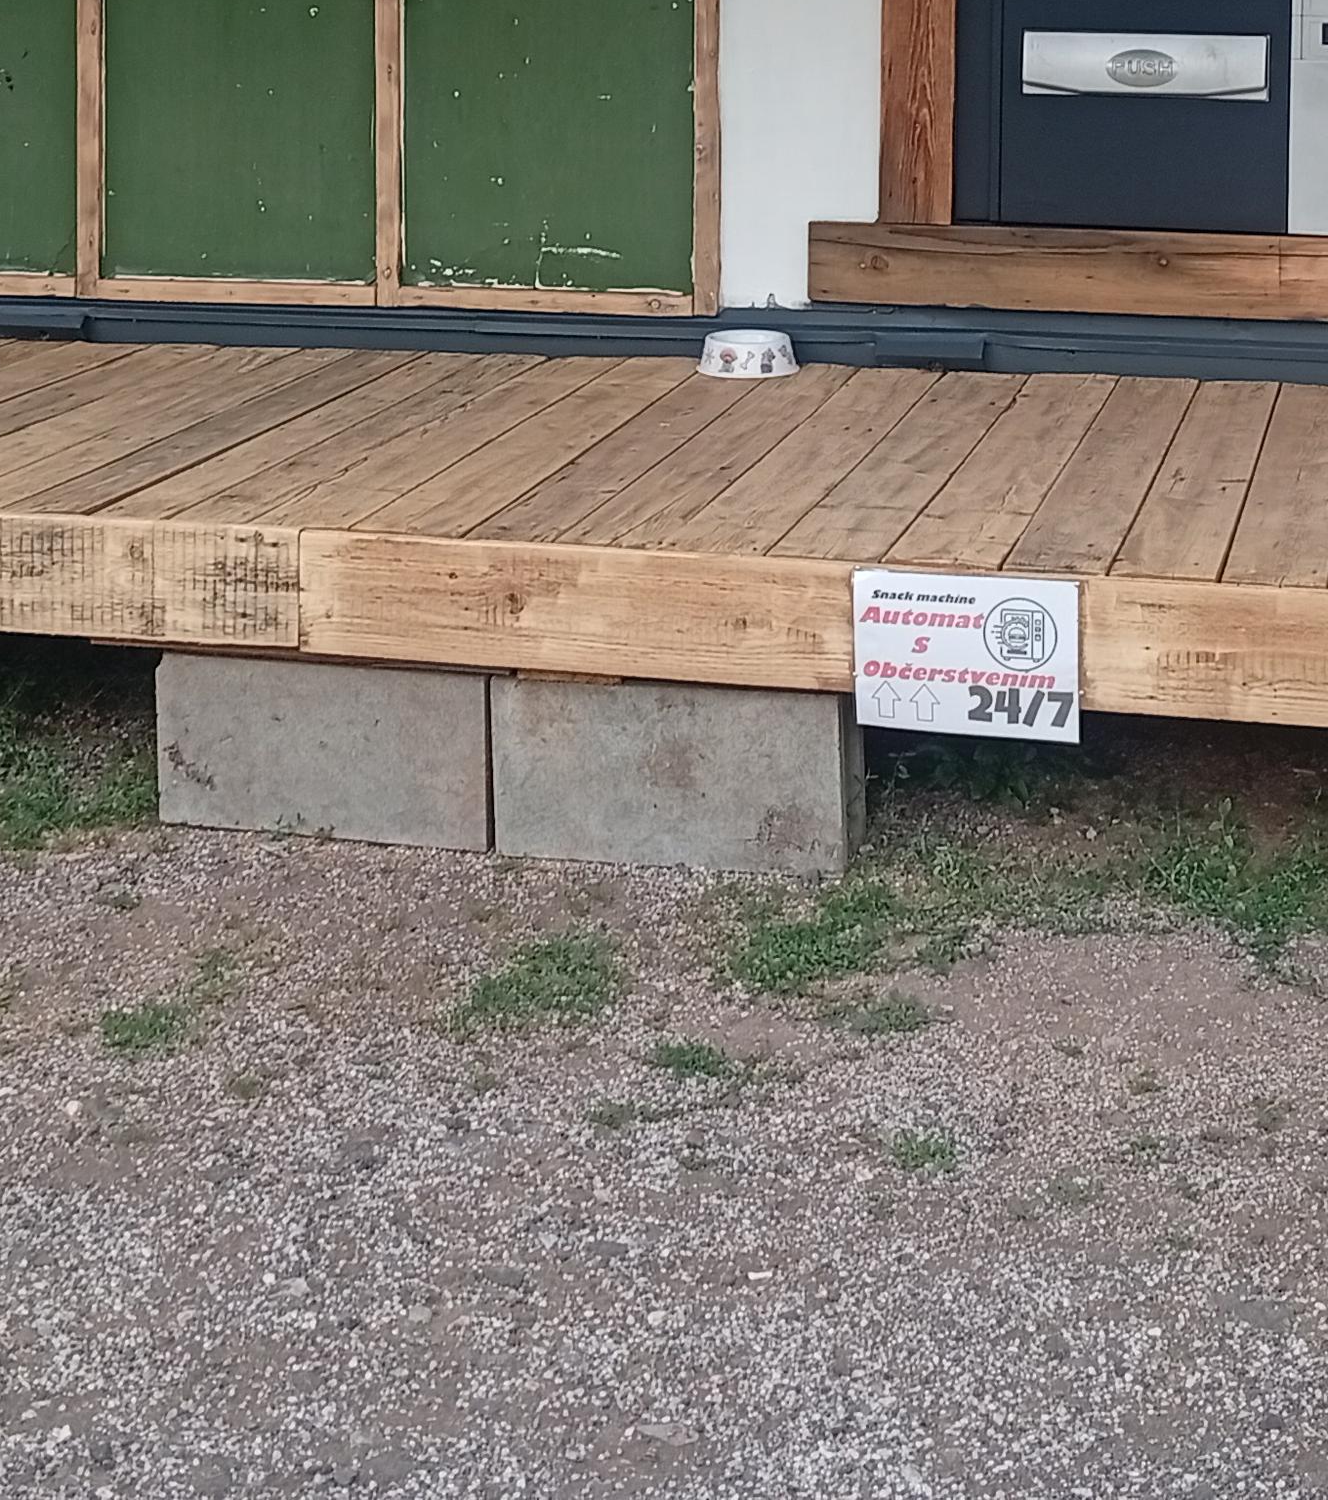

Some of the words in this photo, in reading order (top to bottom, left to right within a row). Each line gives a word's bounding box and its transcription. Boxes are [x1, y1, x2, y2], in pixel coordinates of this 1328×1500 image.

[1111, 58, 1174, 76] PUSH
[872, 589, 914, 601] Snack
[916, 593, 976, 605] machine
[859, 606, 984, 629] Automat
[968, 685, 1074, 728] 24/7
